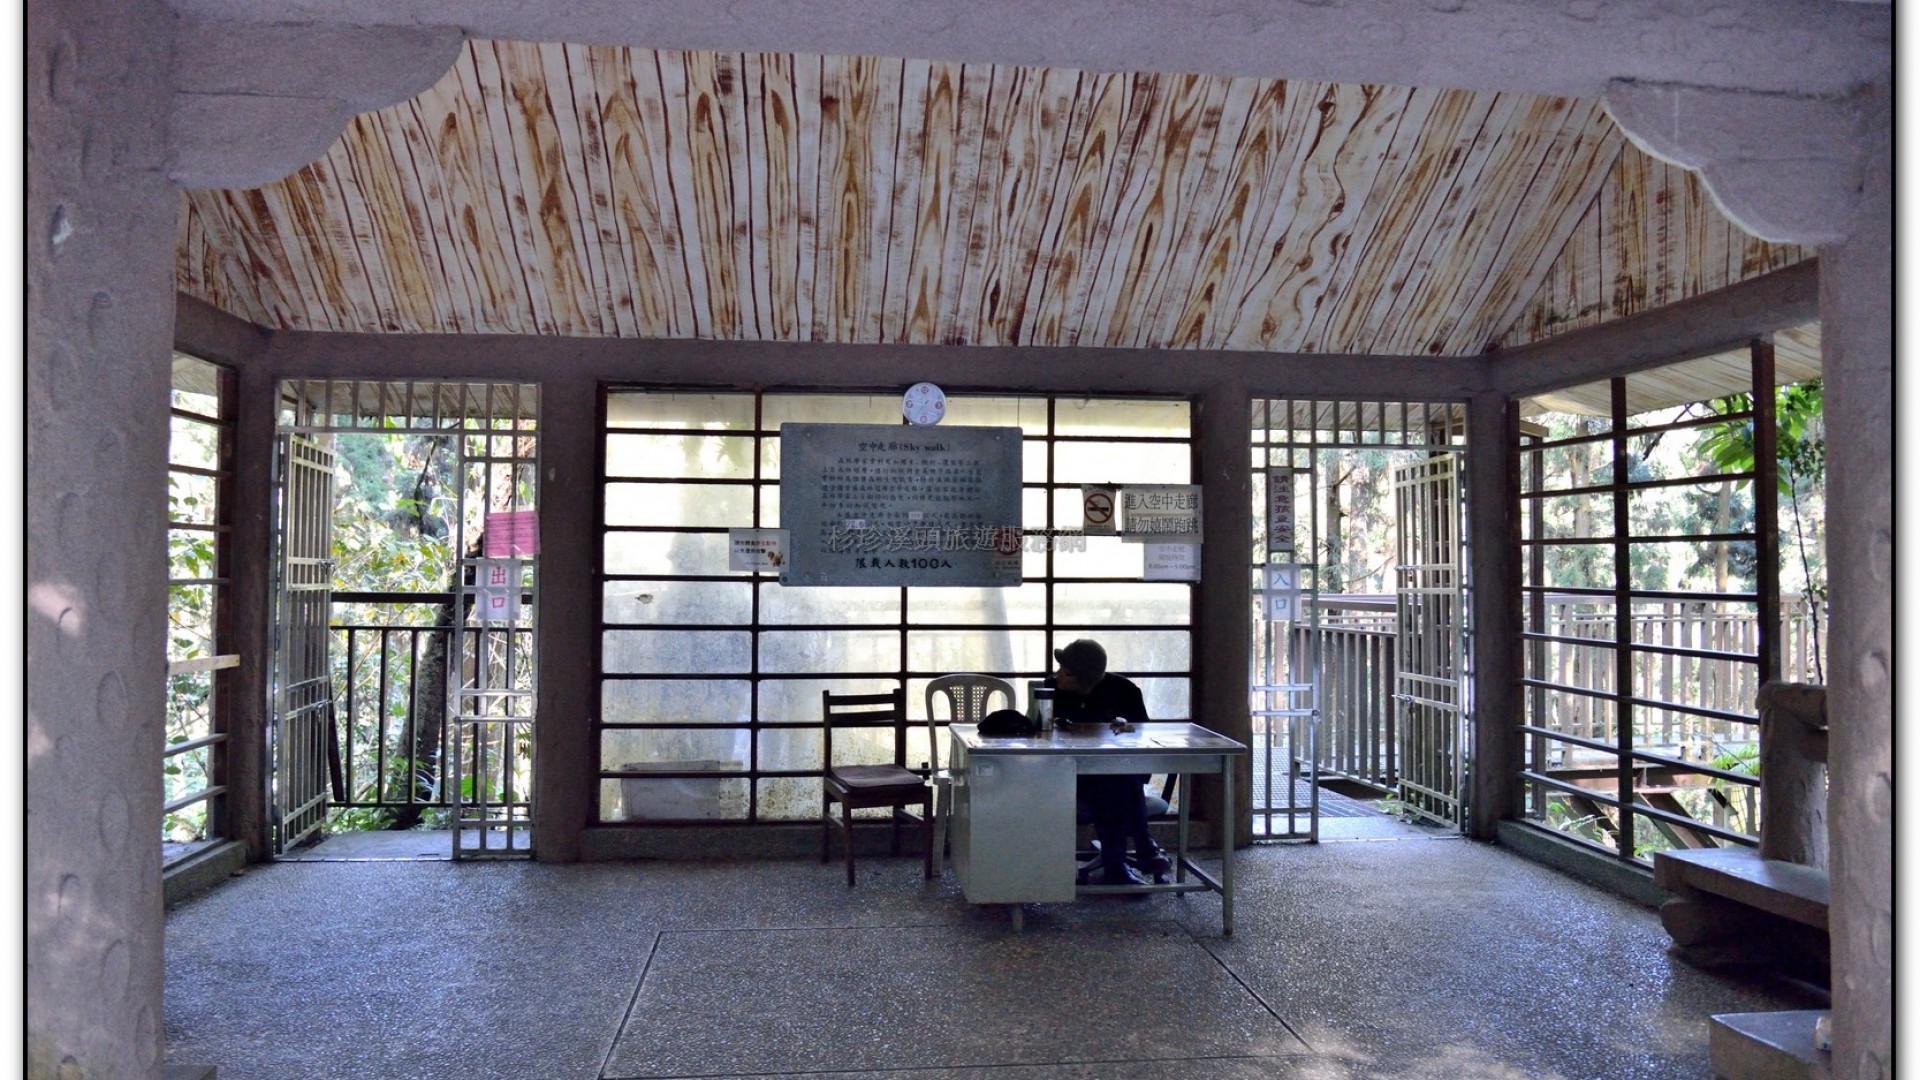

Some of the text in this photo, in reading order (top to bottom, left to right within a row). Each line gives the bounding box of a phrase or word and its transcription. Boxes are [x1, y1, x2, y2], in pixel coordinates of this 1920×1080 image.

[1124, 492, 1199, 510] 進入空中走廊
[1273, 475, 1291, 543] 請注意孩童安全
[491, 566, 506, 609] 出口
[1272, 572, 1290, 610] 入口
